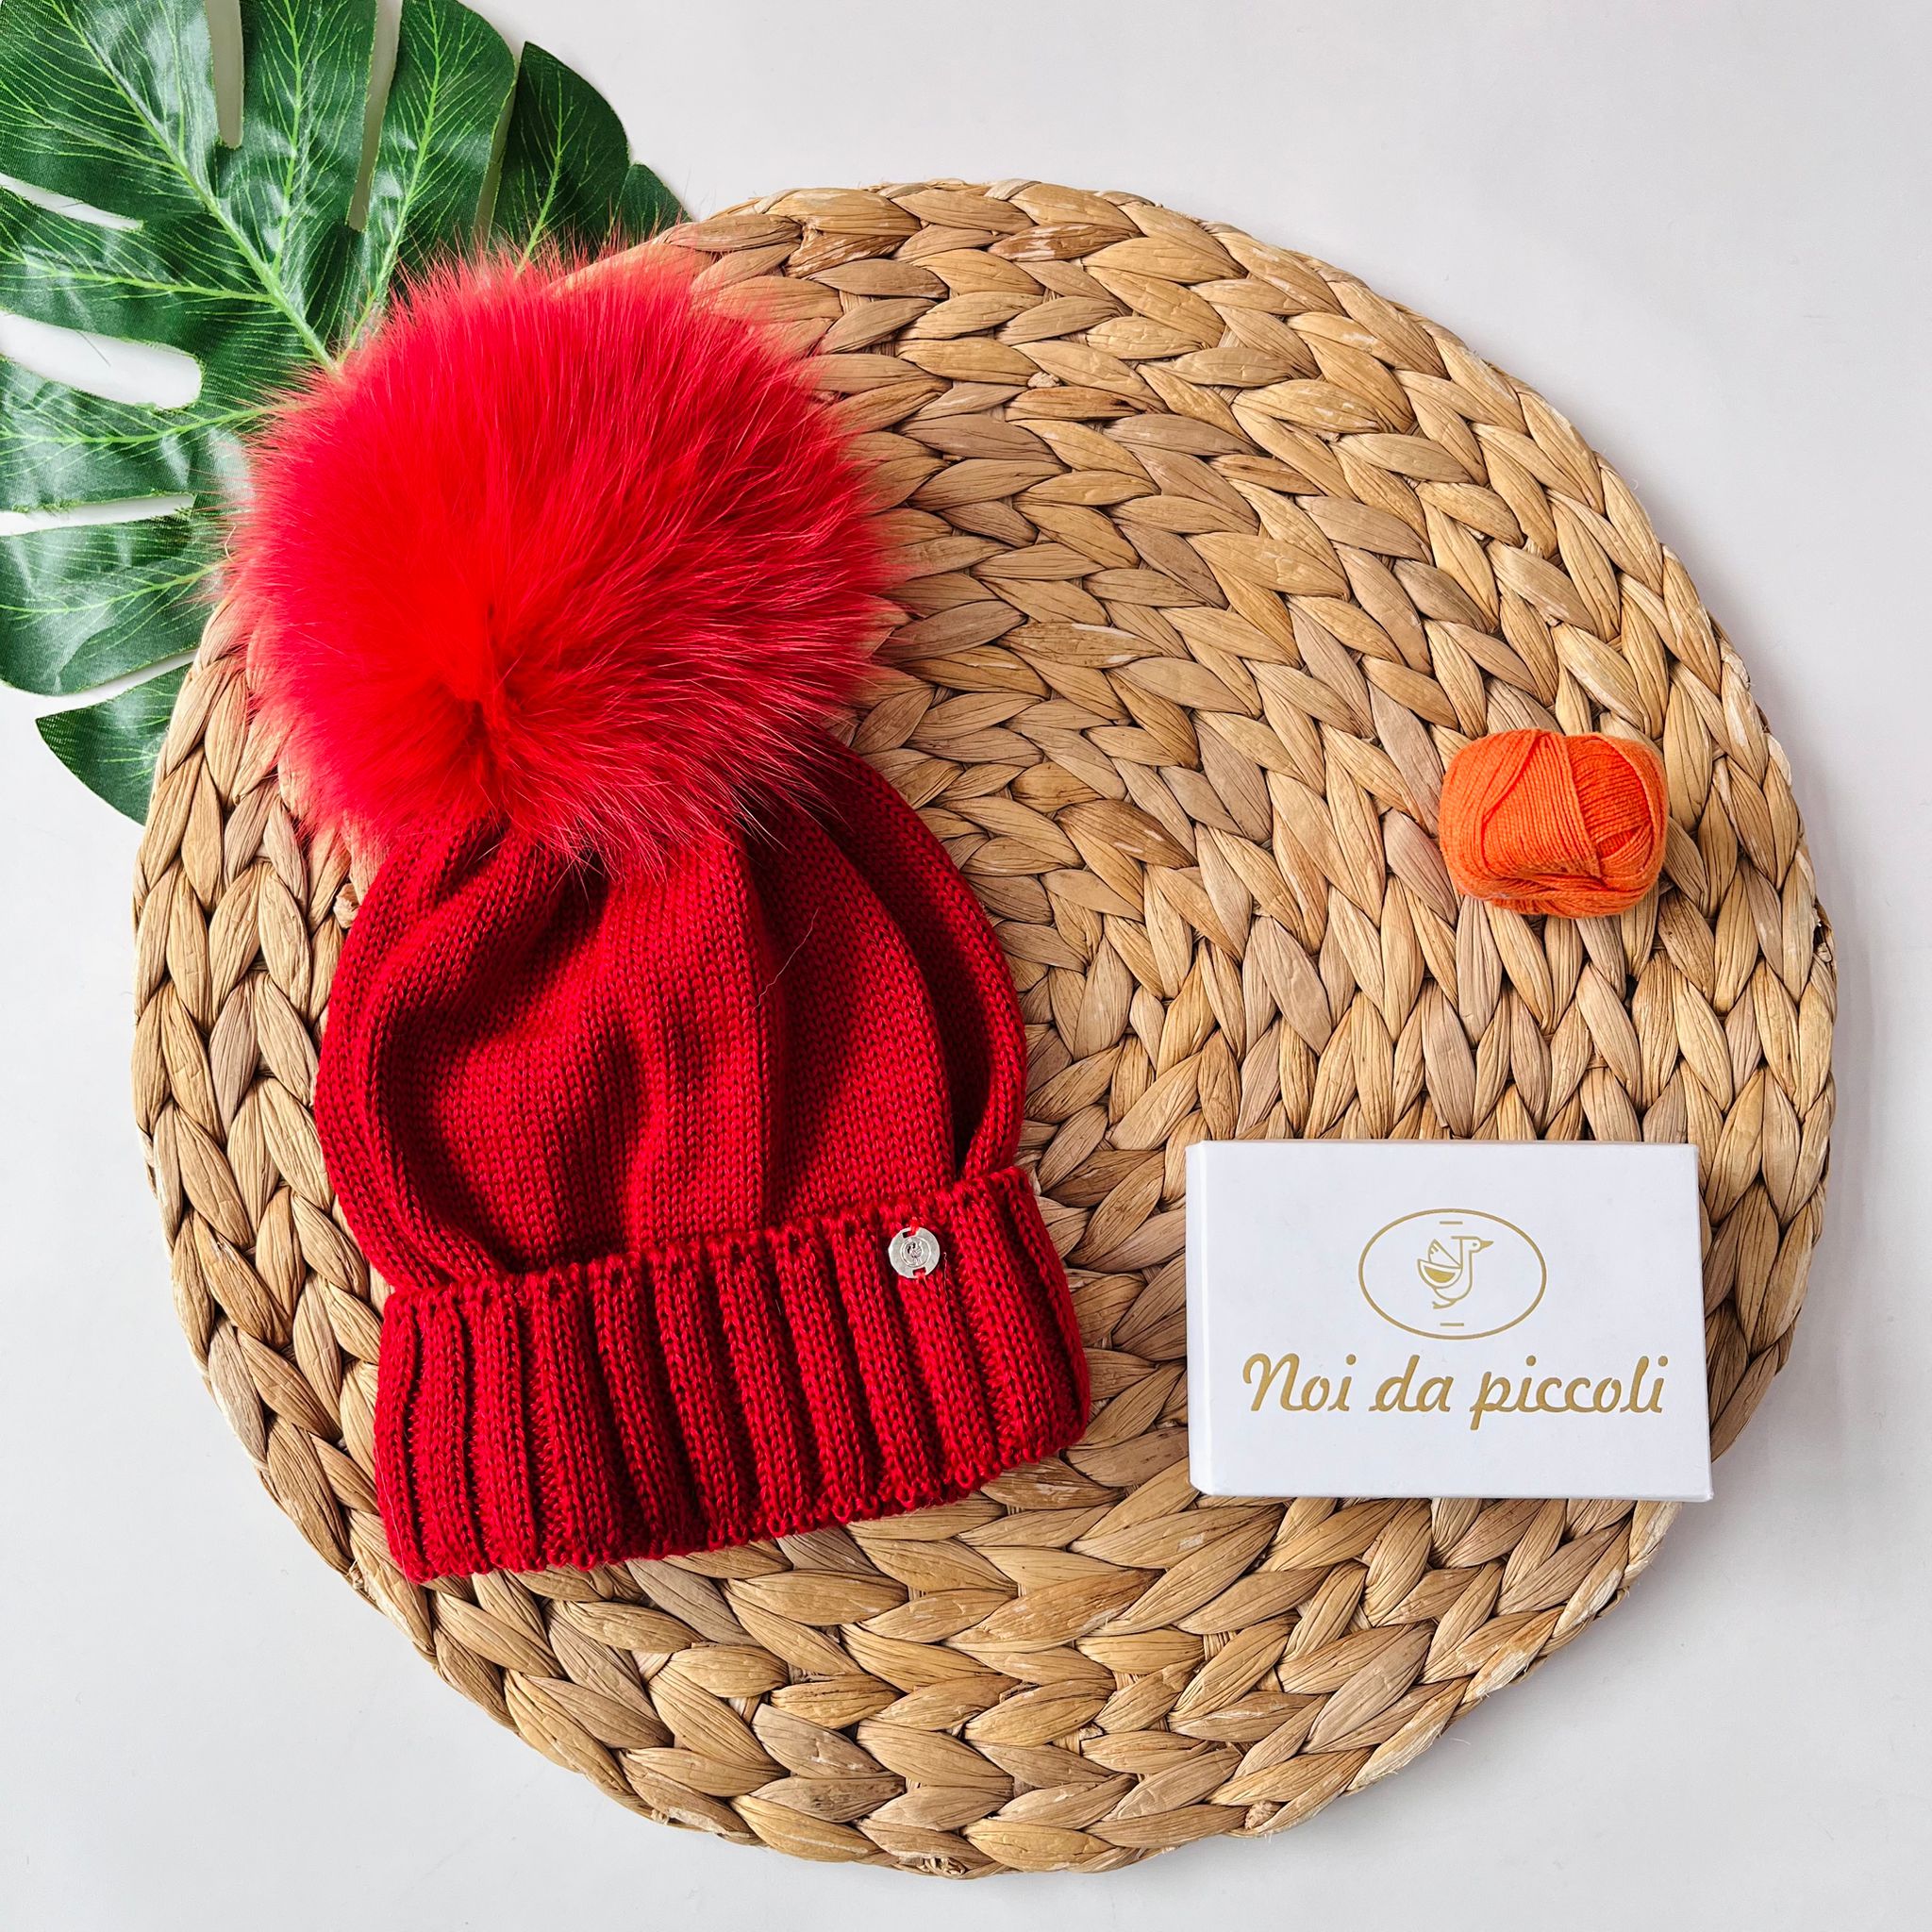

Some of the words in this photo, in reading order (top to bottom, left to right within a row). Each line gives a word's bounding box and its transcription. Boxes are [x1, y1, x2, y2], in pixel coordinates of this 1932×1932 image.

[1242, 1352, 1357, 1412] Noi
[1368, 1355, 1455, 1413] da
[1470, 1355, 1669, 1431] piccoli
